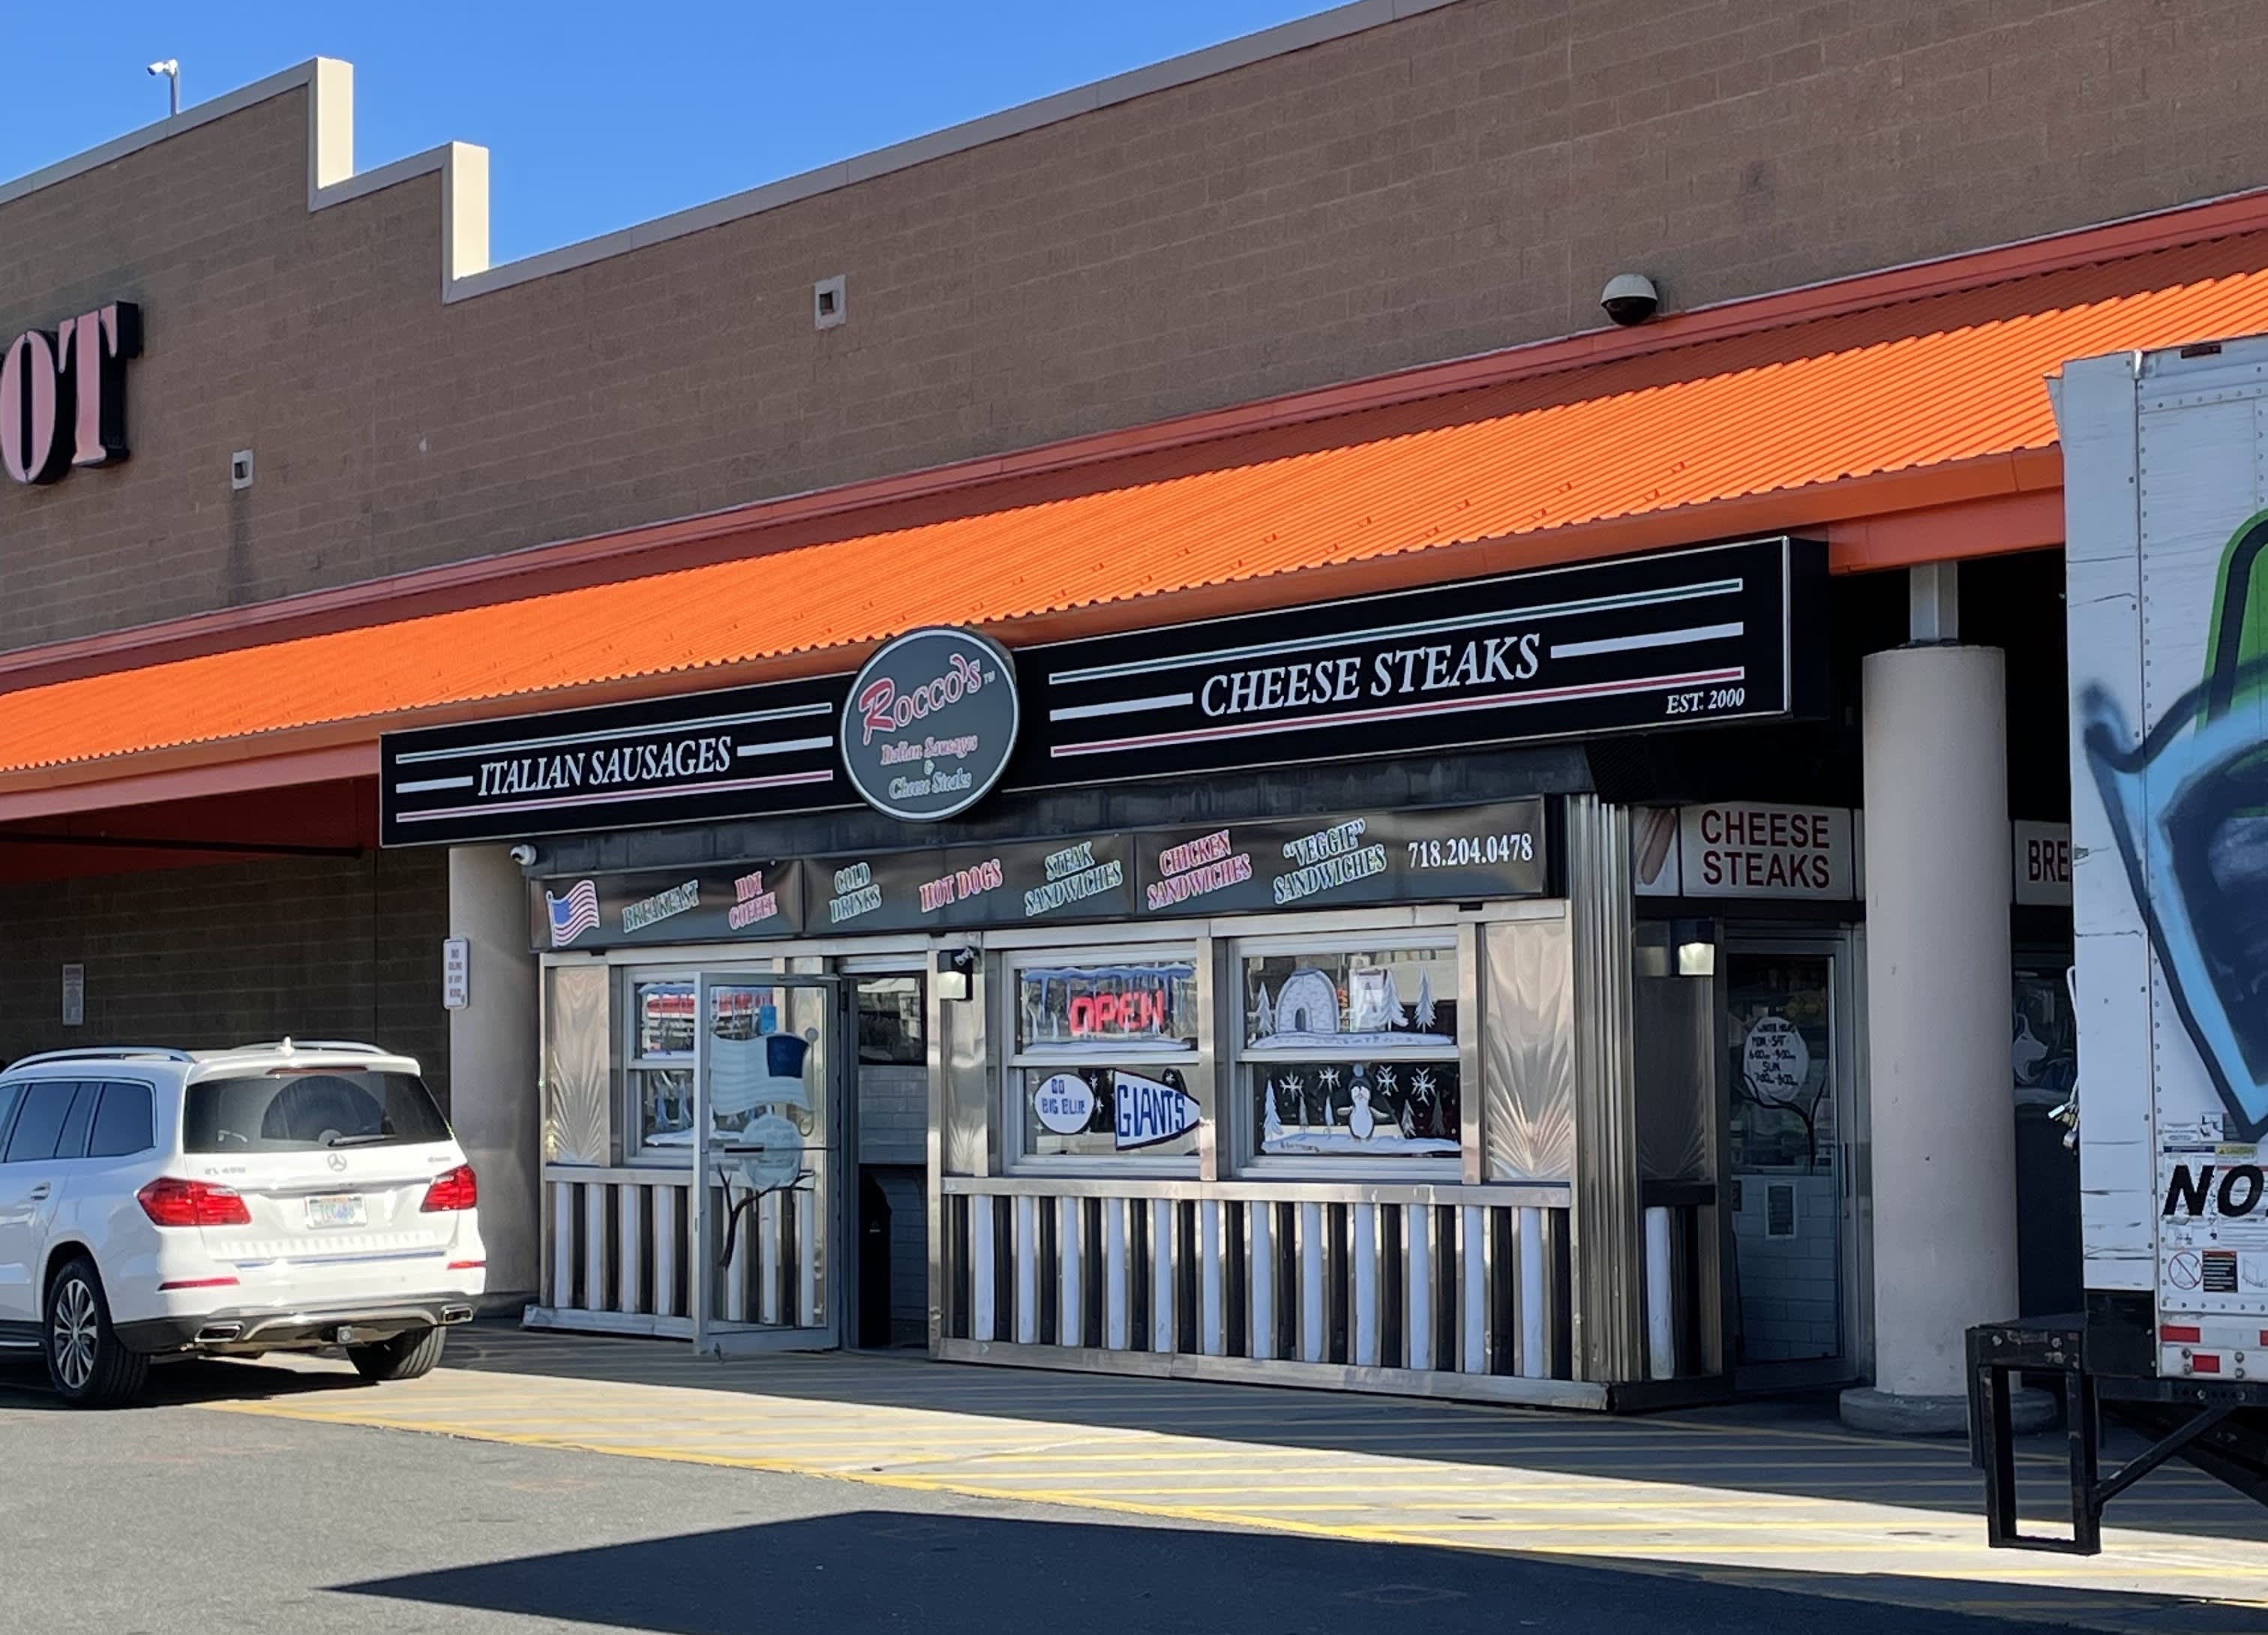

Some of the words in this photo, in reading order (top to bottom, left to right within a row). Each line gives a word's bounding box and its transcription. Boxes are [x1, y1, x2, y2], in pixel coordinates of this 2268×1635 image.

[1201, 656, 1361, 716] CHEESE
[1370, 633, 1540, 697] STEAKS
[1665, 691, 1704, 714] EST.
[1708, 687, 1745, 710] 2000
[478, 752, 586, 796] ITALIAN
[589, 736, 731, 785] SAUSAGES
[888, 776, 930, 800] Cheese
[932, 767, 973, 794] Steaks
[1701, 809, 1830, 849] CHEESE
[1045, 841, 1095, 881] STEAK
[1159, 830, 1232, 877] CHICKEN
[1407, 833, 1534, 869] 718.204.0478
[1702, 850, 1830, 889] STEAKS
[2028, 839, 2072, 883] BRE
[734, 870, 763, 903] HOT
[834, 862, 872, 895] COLD
[919, 874, 955, 913] HOT
[956, 859, 1003, 900] DOGS
[1024, 860, 1123, 916] SANDWICHES
[1147, 853, 1252, 910] SANDWICHES
[1273, 844, 1387, 904] SANDWICHES
[622, 879, 700, 934] BREAKFAST
[728, 892, 778, 930] COFFEE
[829, 884, 882, 924] DRINKS
[1069, 989, 1166, 1036] OPEN
[1041, 1097, 1059, 1115] BIG
[1061, 1097, 1086, 1115] BLUE
[1051, 1078, 1065, 1095] GO
[1117, 1084, 1186, 1138] GIANTS
[2162, 1164, 2268, 1218] NO
